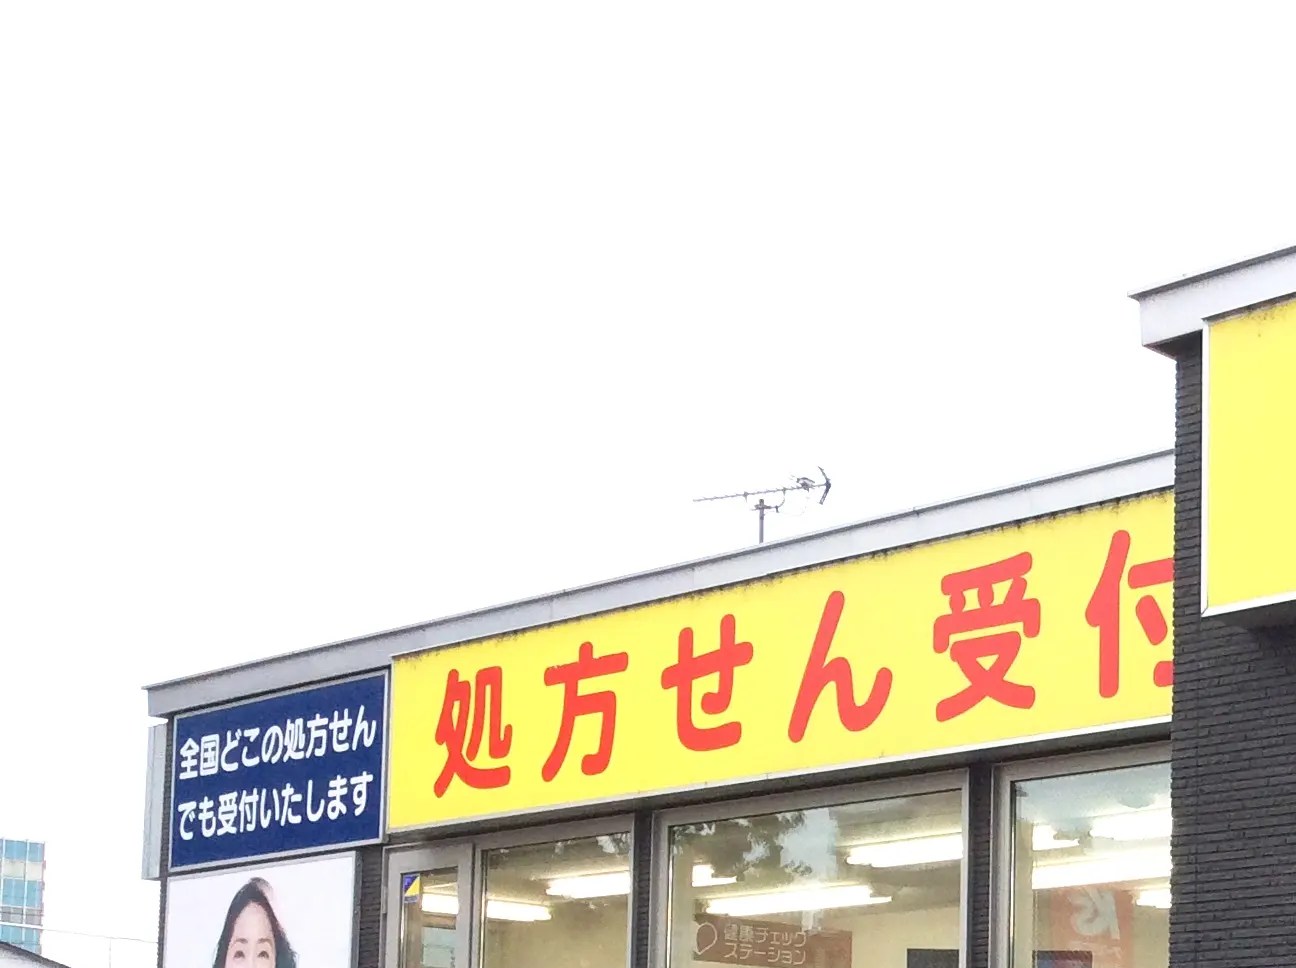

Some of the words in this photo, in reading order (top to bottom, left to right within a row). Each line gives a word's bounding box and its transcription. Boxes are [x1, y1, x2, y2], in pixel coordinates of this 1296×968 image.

[179, 705, 376, 779] 全国どこの処方せん
[177, 771, 373, 840] でも受付いたします
[724, 924, 806, 947] 健康チェック
[724, 942, 806, 965] ステーション
